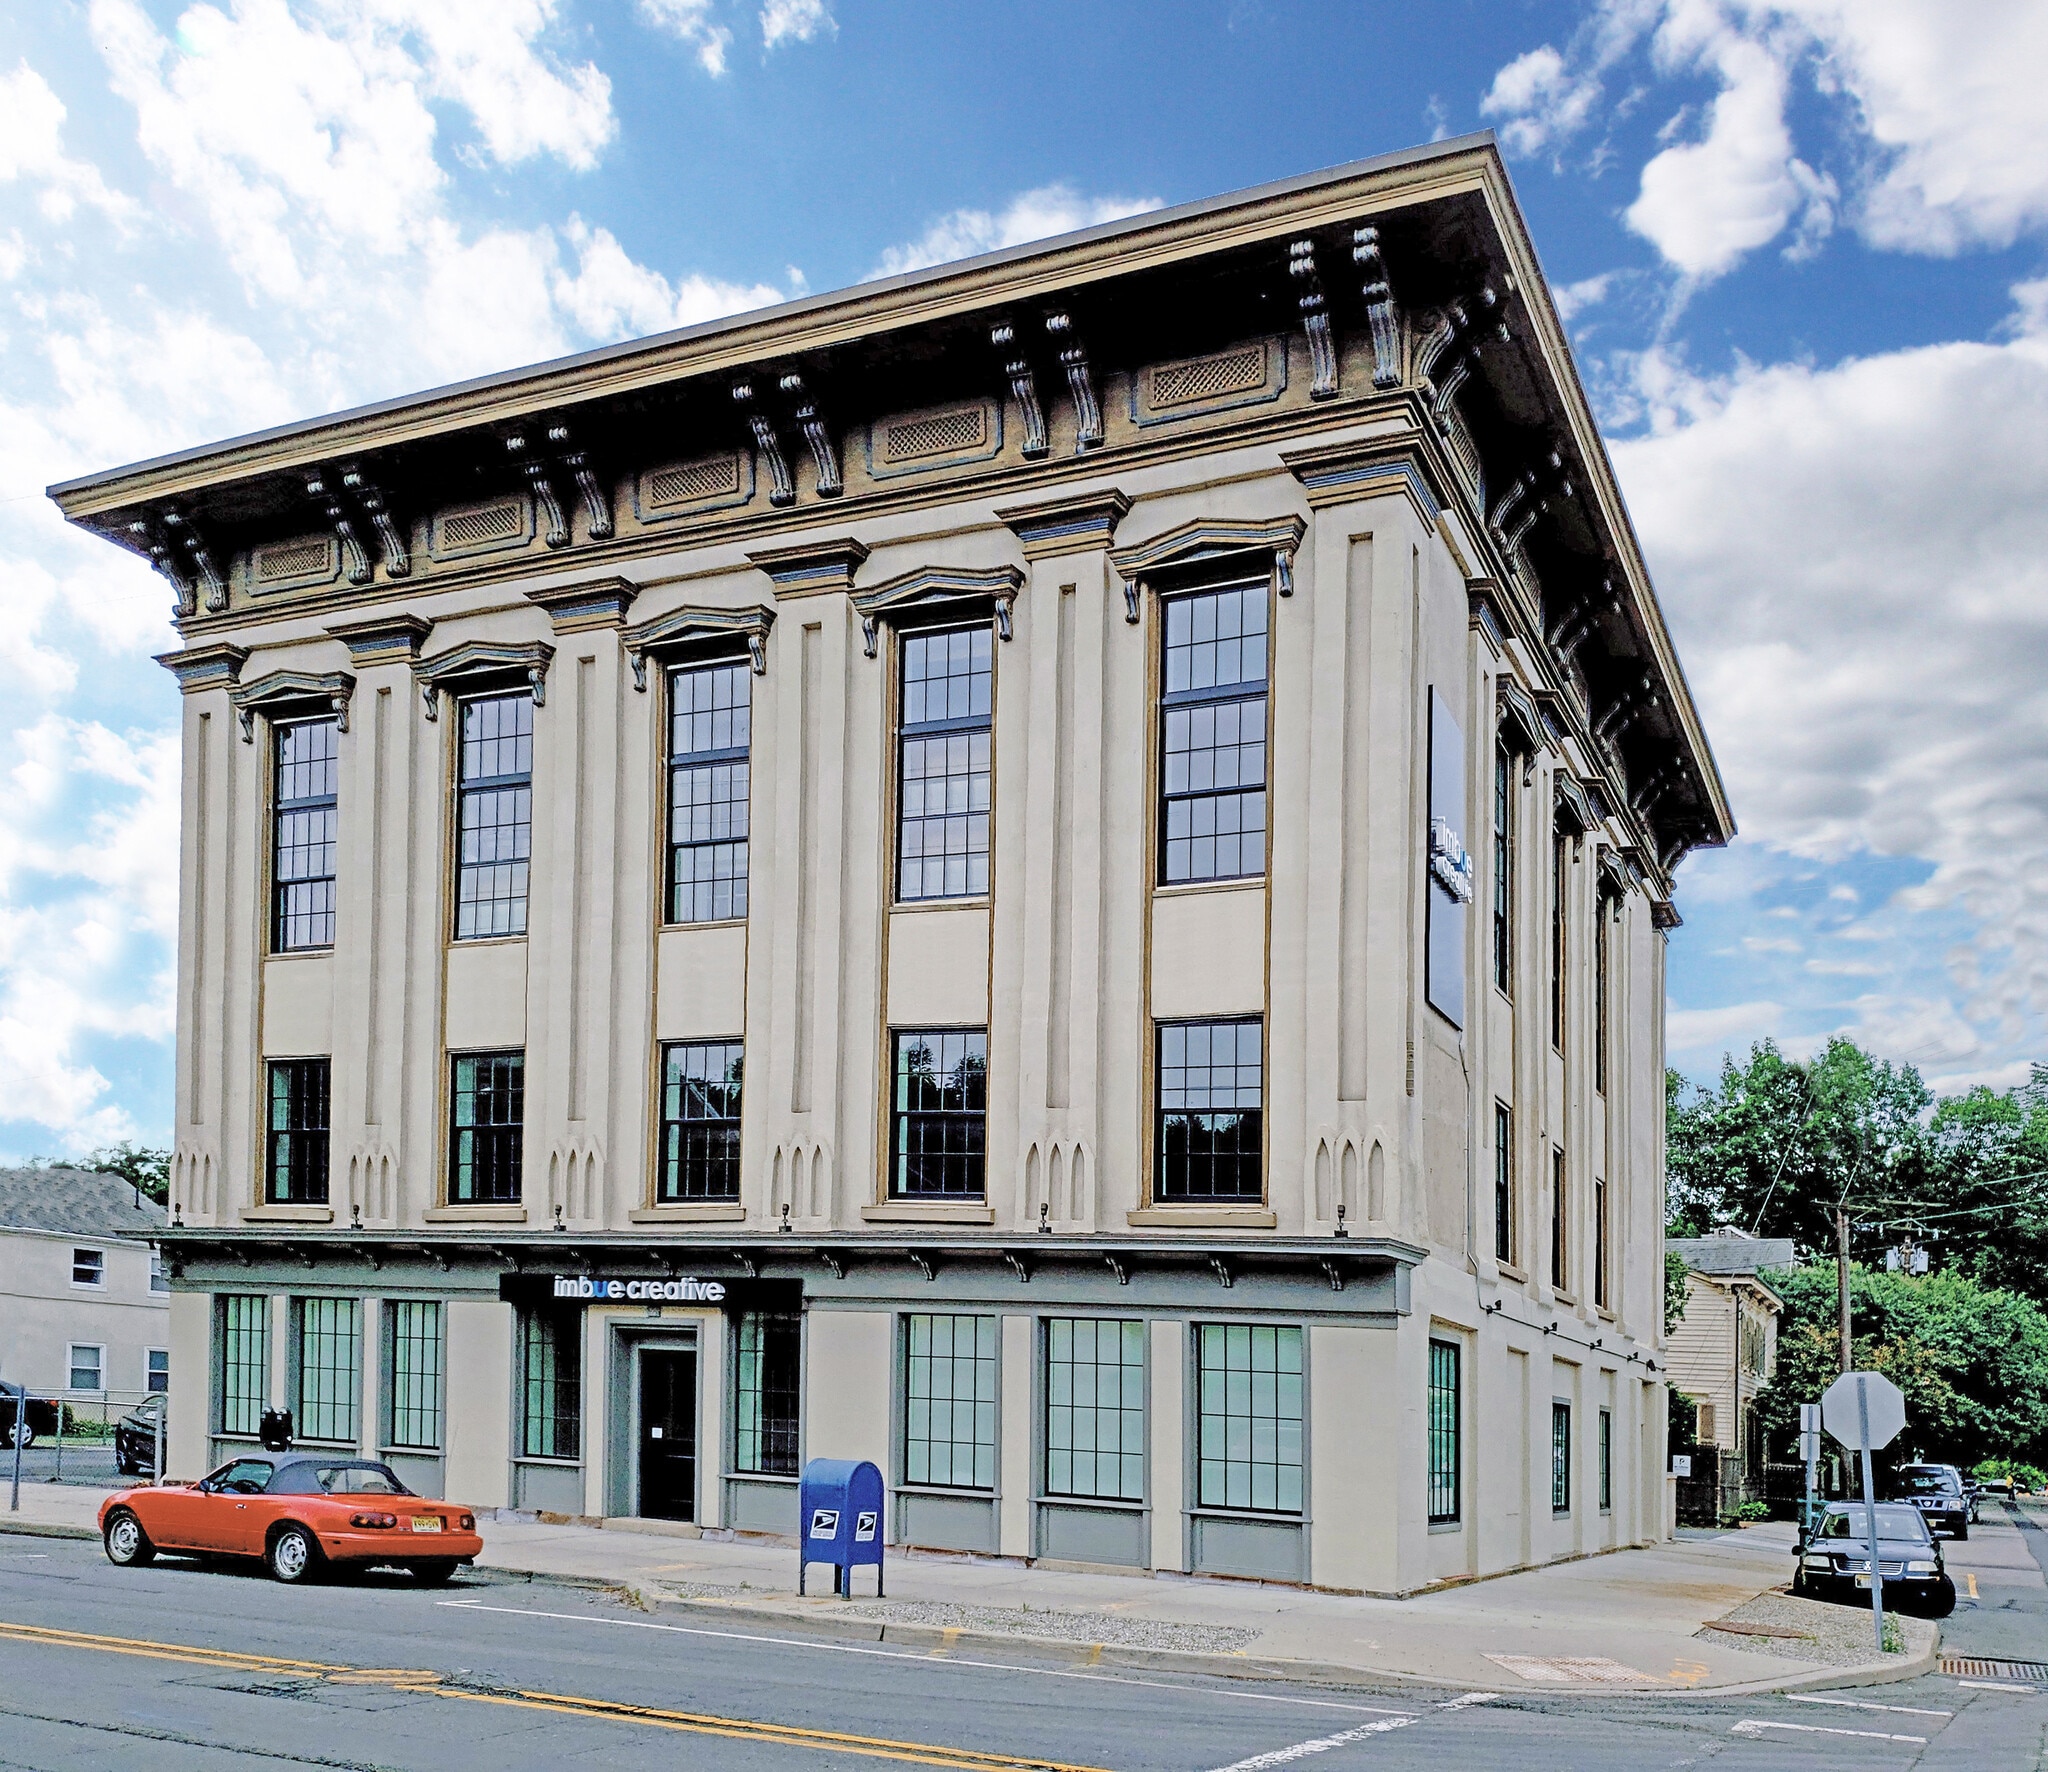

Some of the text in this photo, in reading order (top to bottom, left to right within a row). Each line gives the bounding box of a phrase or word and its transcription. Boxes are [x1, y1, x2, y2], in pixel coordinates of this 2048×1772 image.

[1434, 816, 1473, 879] imbue
[554, 1275, 726, 1301] imbue creative
